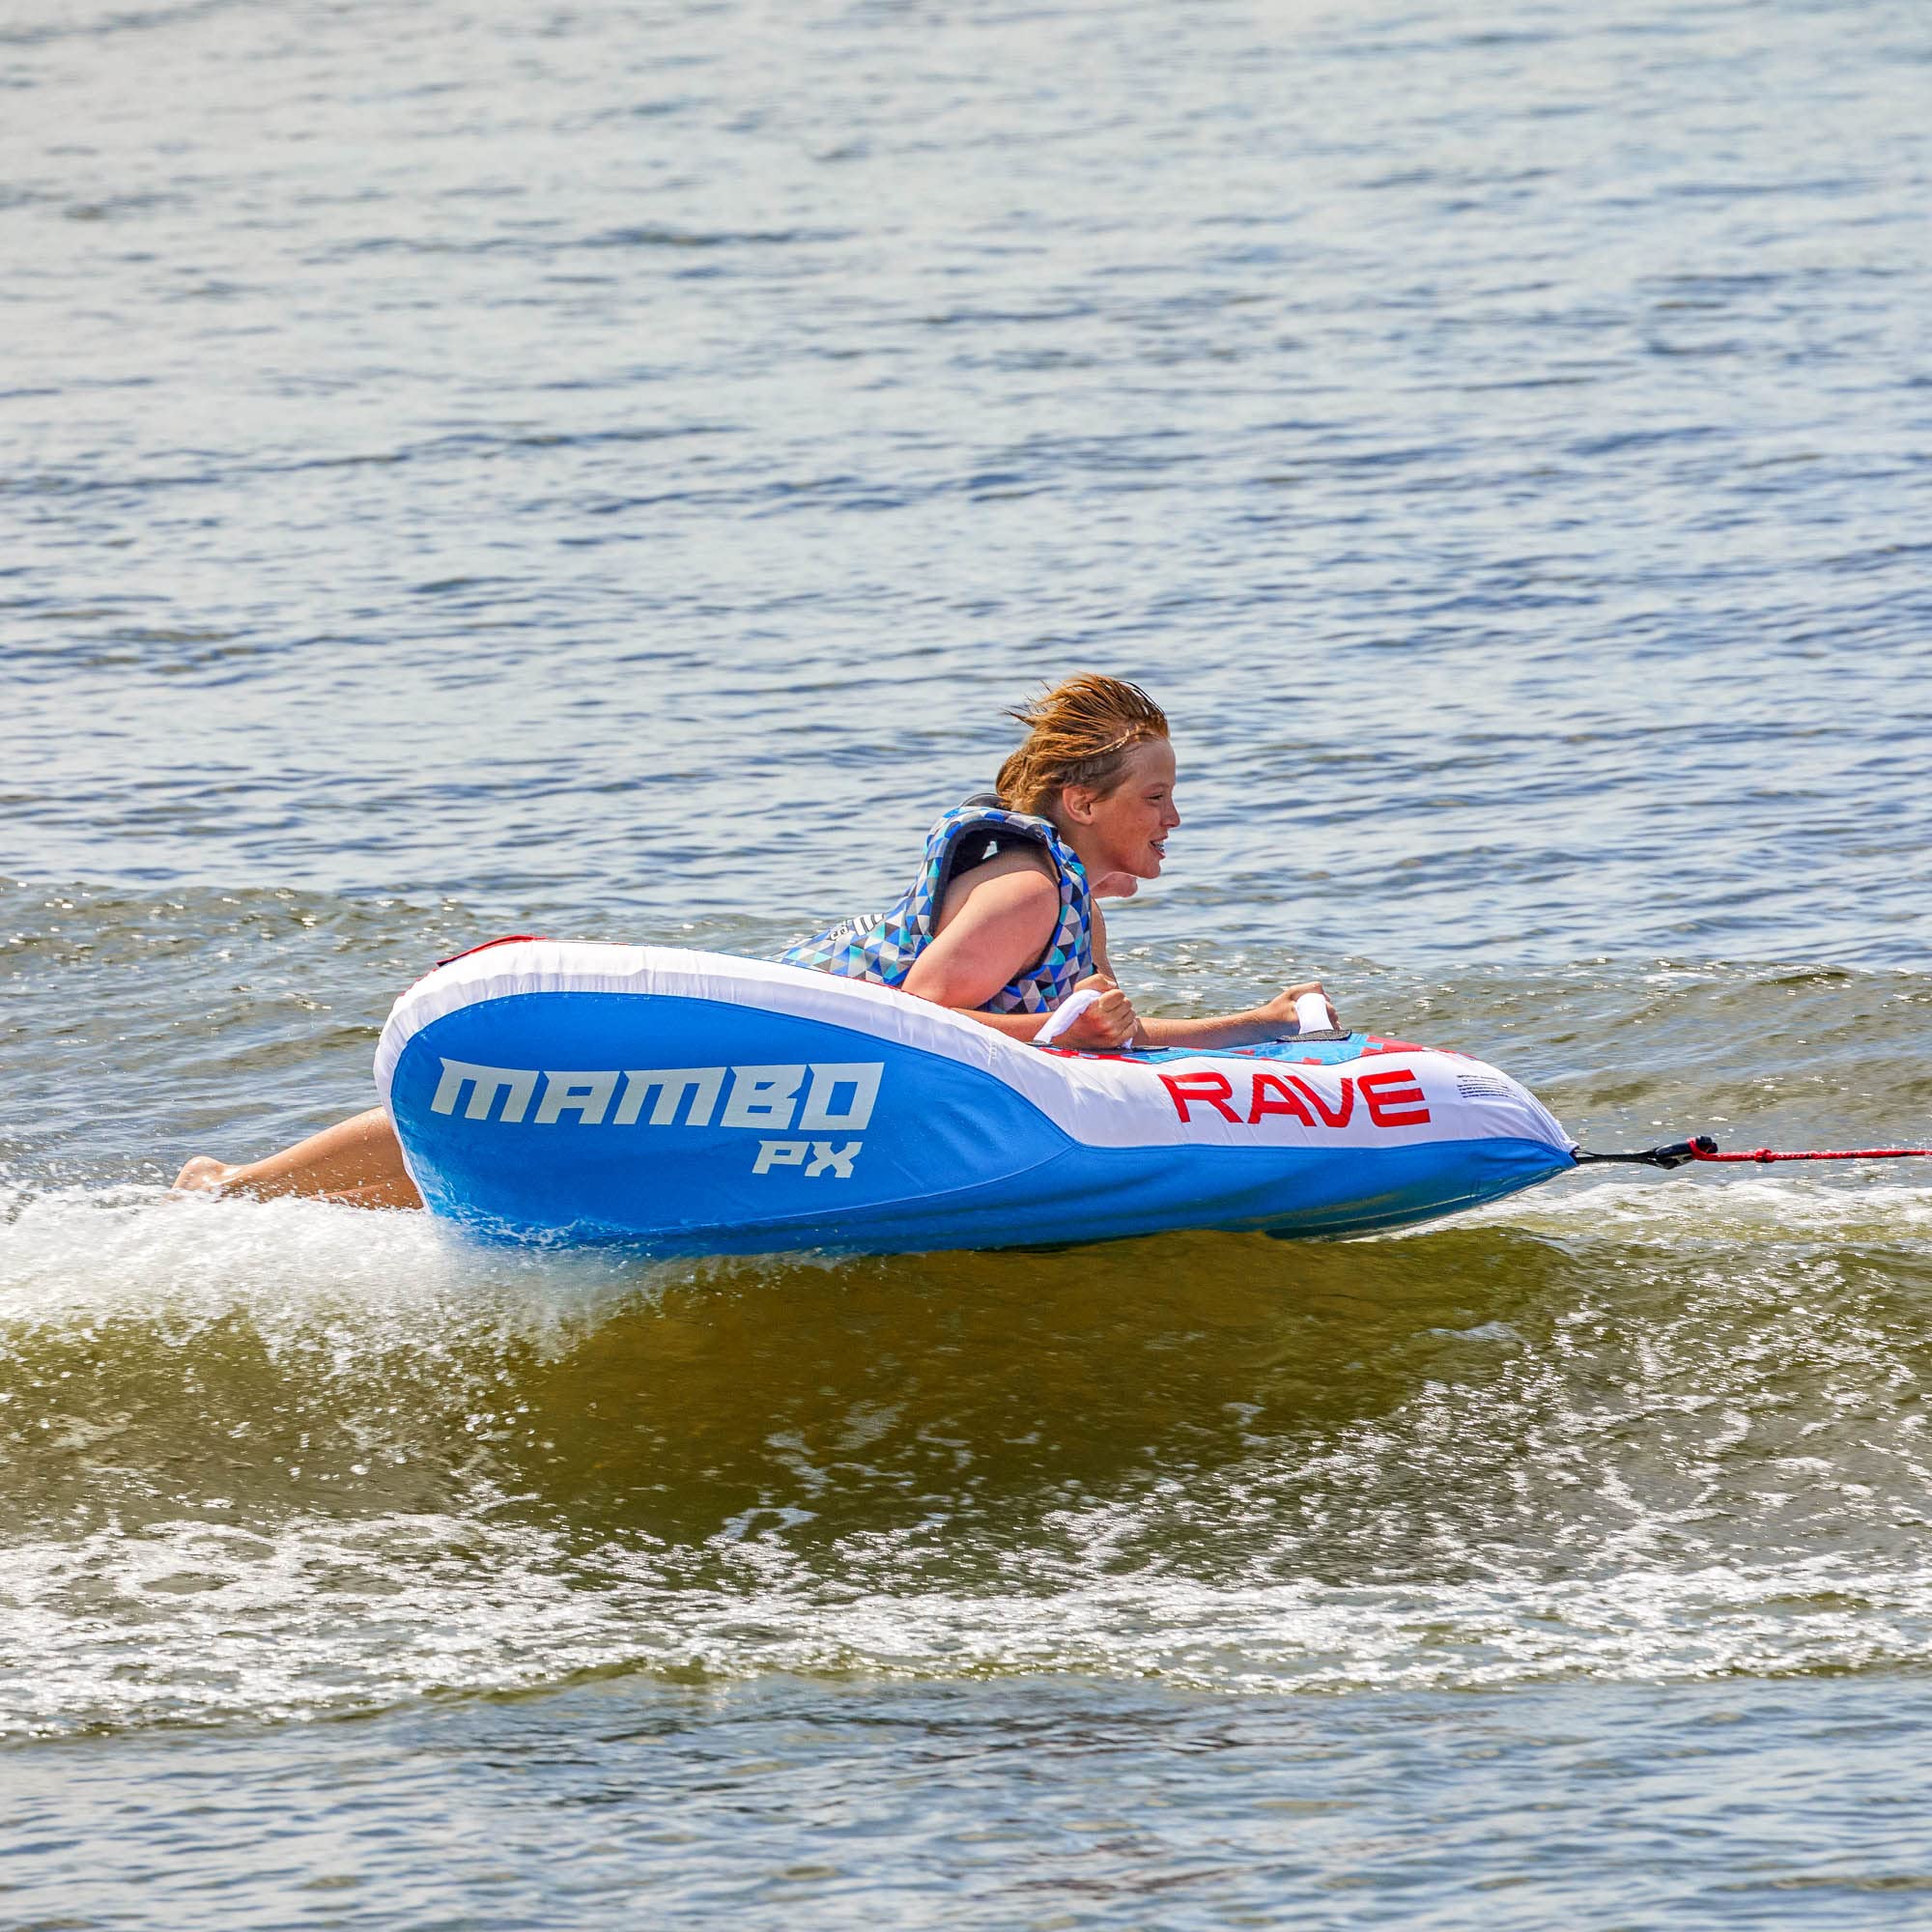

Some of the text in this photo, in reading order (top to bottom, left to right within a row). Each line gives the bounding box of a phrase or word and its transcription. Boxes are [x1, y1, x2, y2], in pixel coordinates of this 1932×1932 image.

[431, 1058, 884, 1130] MAMBO
[1157, 1069, 1431, 1127] RAVE
[753, 1141, 862, 1179] PX
